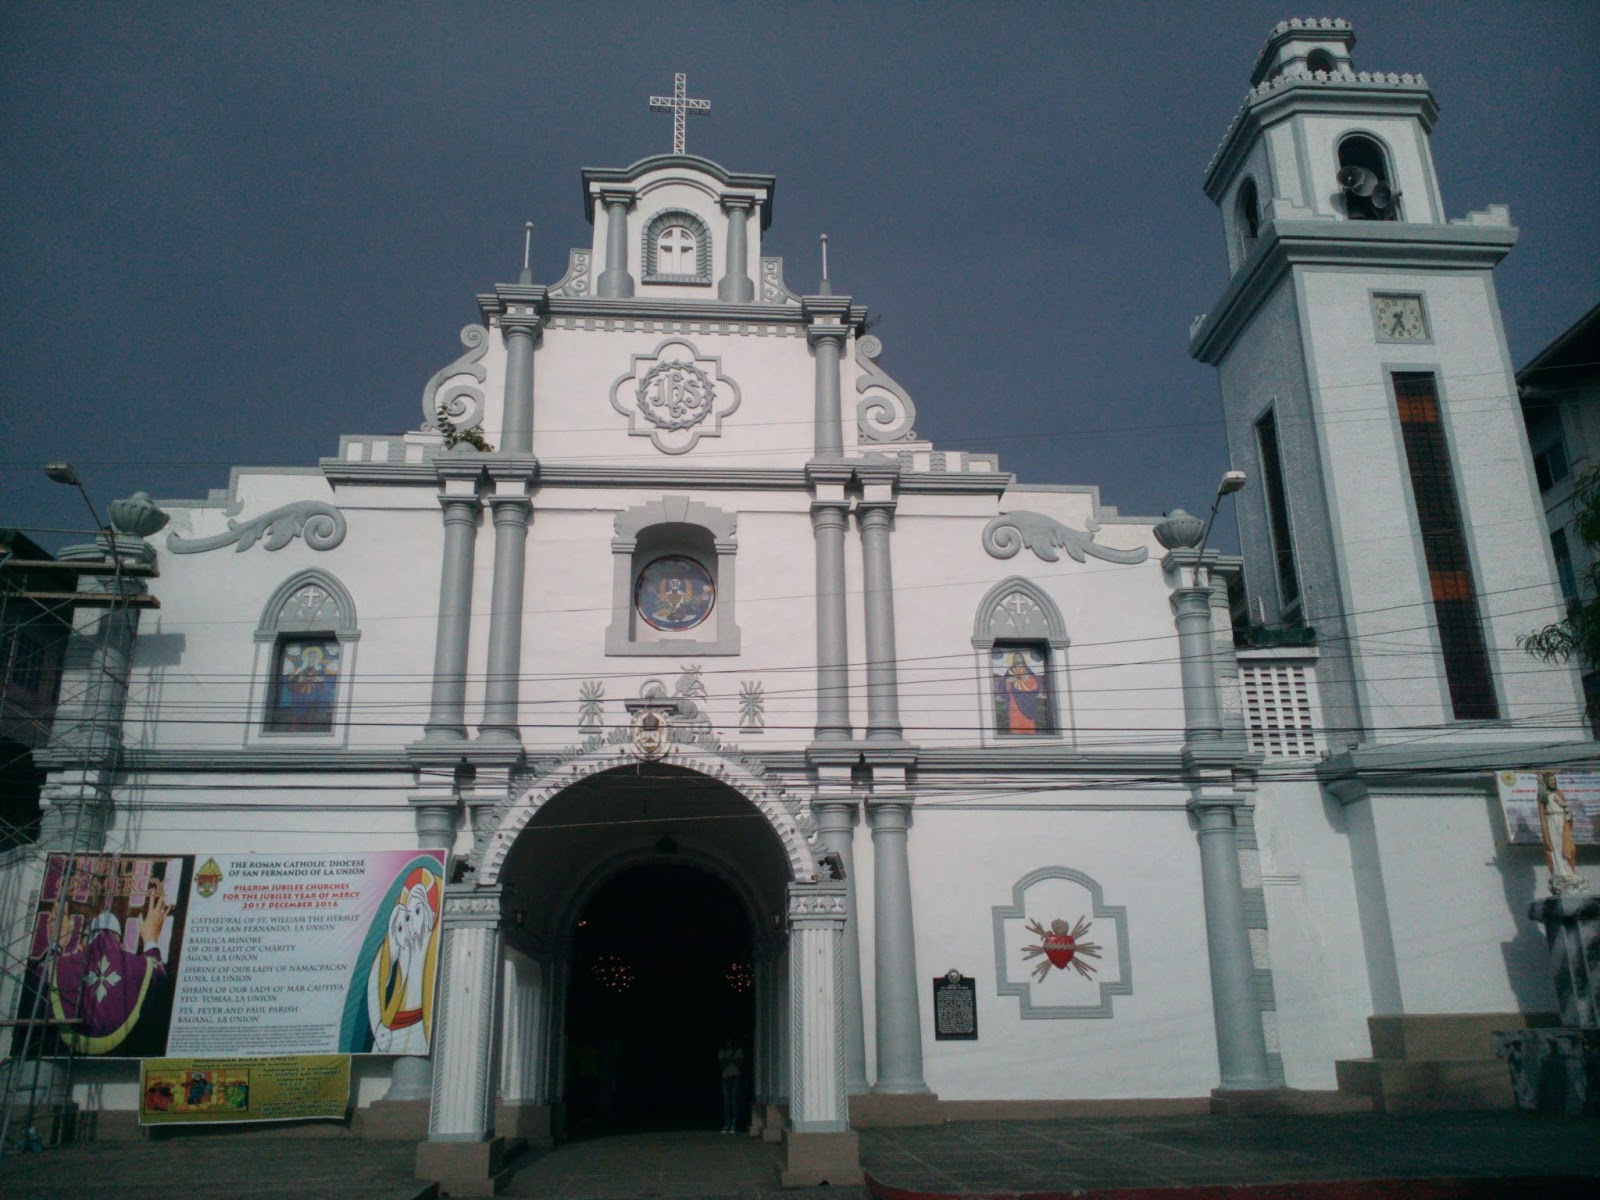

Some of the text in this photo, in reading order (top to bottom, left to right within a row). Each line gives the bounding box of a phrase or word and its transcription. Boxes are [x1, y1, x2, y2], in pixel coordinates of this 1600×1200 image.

[330, 860, 365, 868] DIOCESE
[305, 882, 350, 890] CHURCHES
[326, 914, 360, 922] HERMIT
